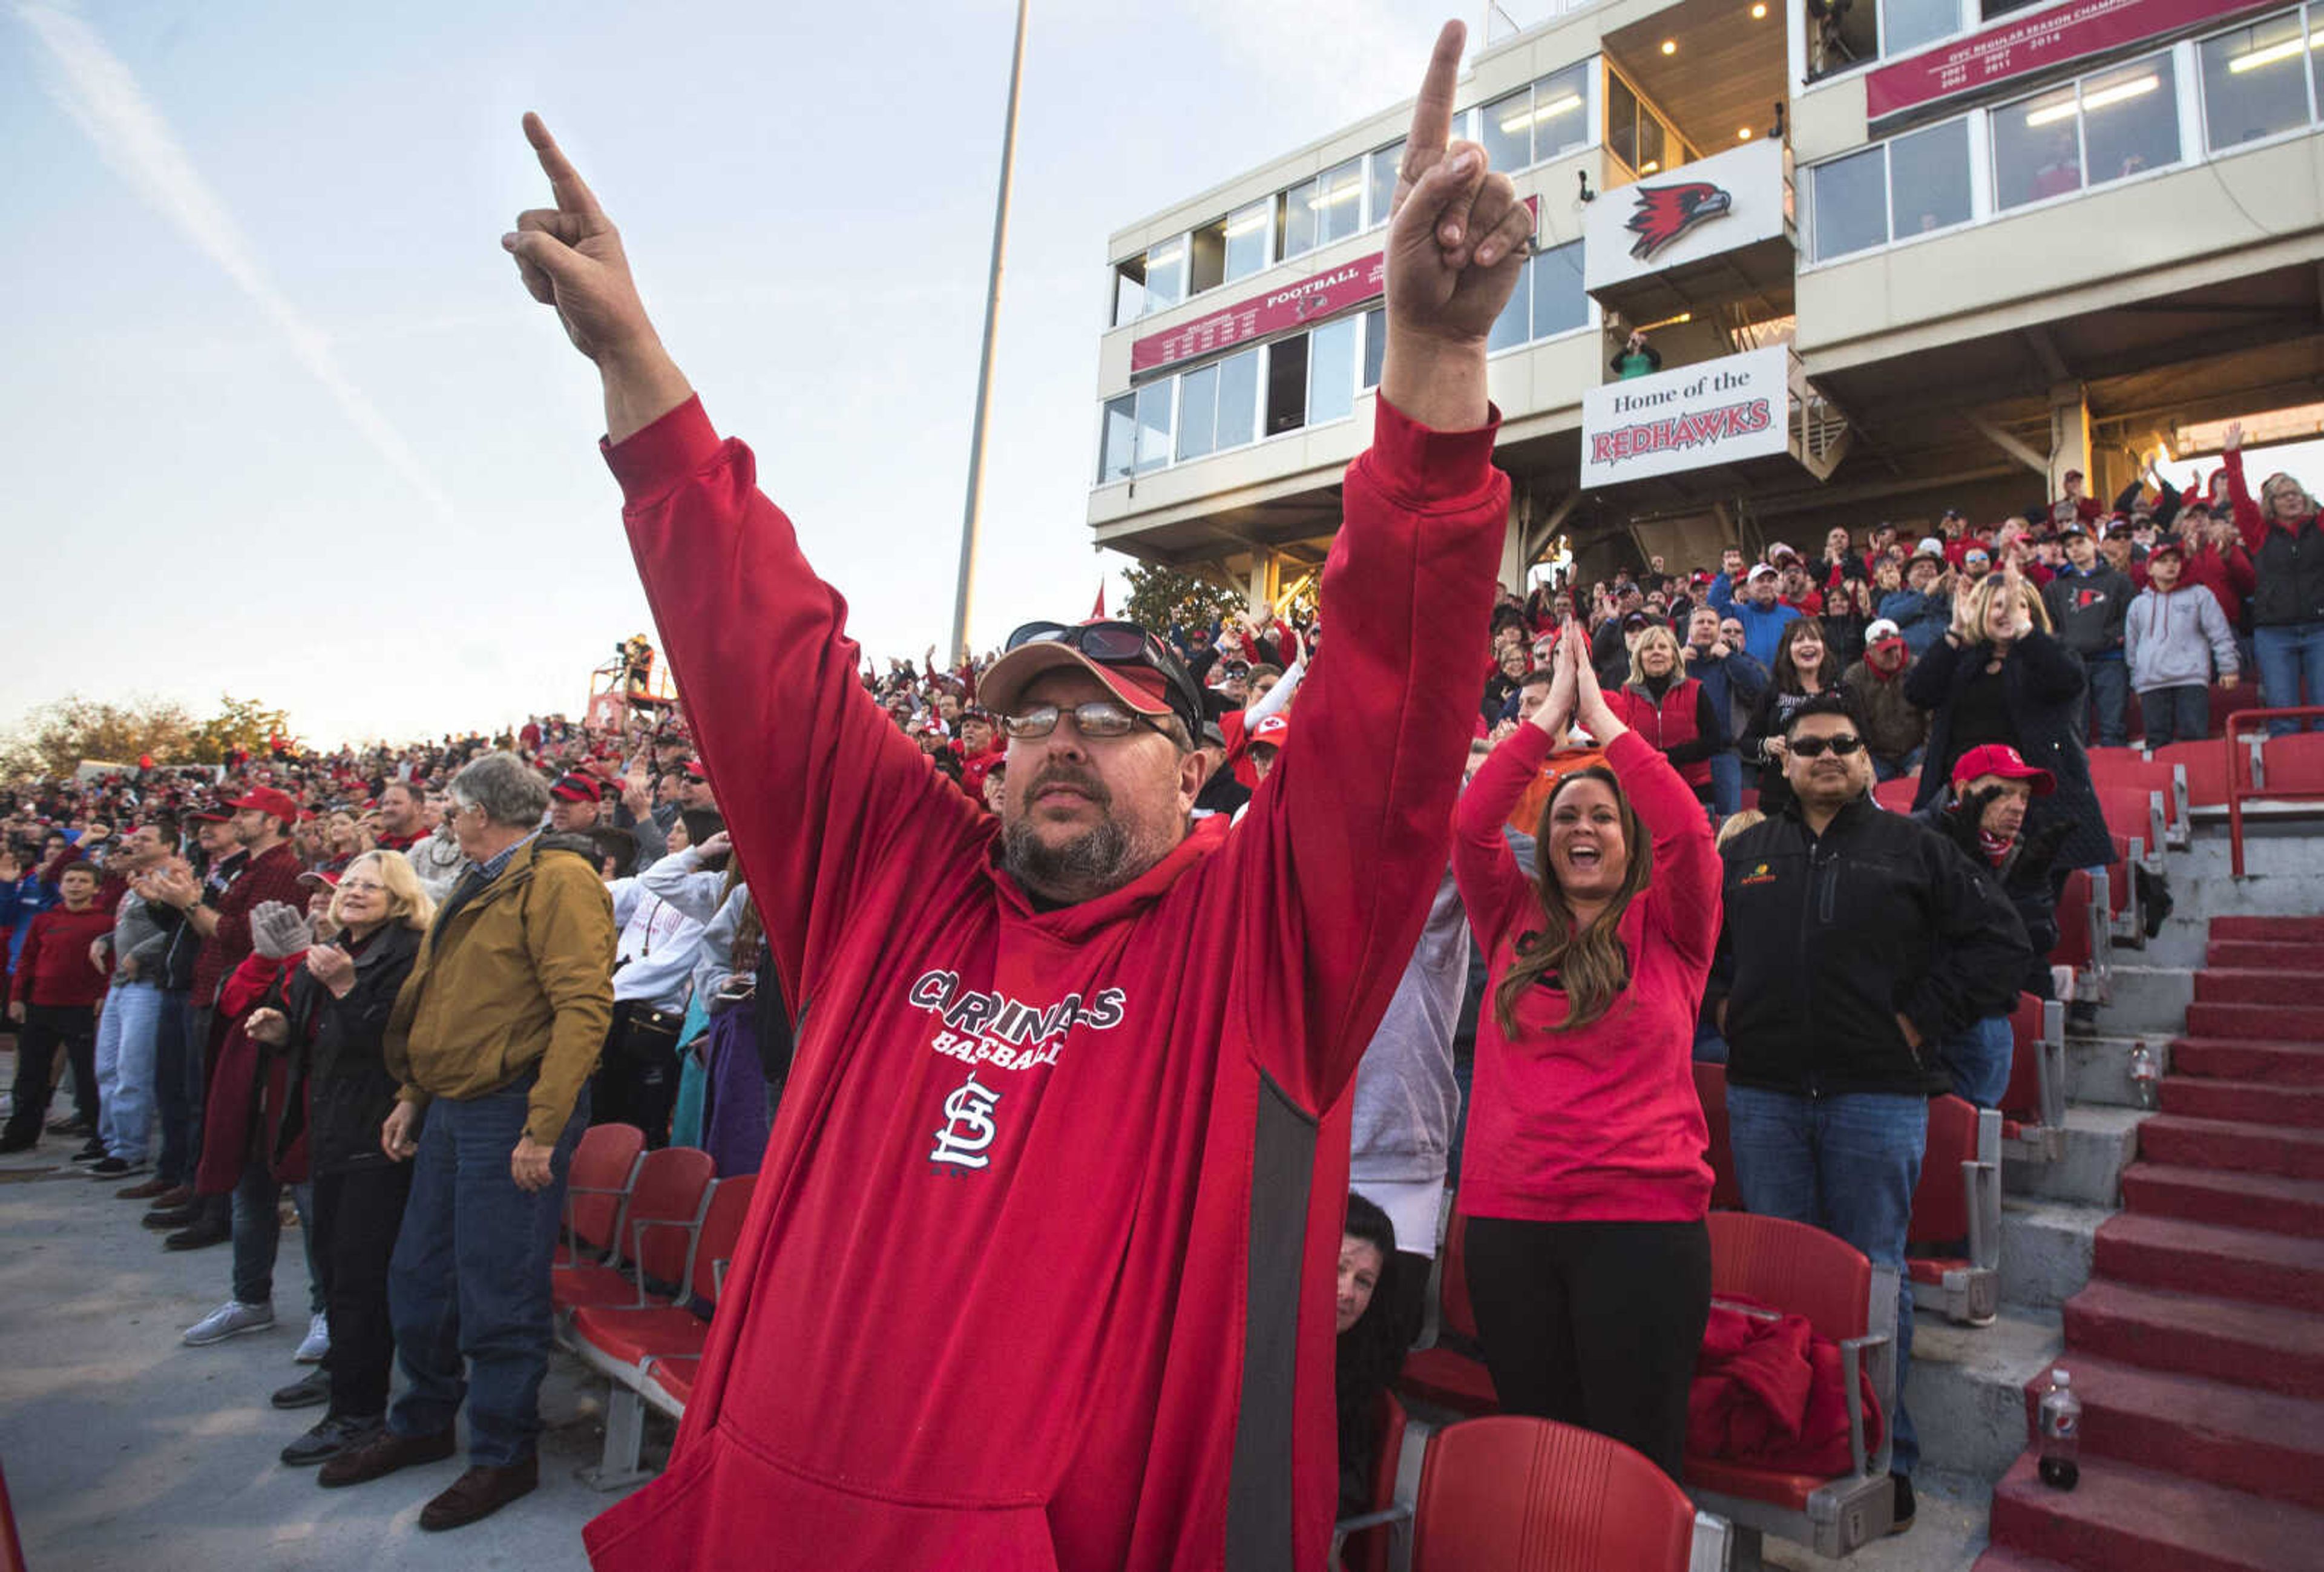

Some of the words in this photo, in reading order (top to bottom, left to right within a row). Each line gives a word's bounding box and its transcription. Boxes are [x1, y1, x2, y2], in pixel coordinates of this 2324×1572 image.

[1974, 30, 2023, 55] REGULAR
[2027, 15, 2071, 33] SEASON
[1985, 60, 2011, 75] 2011
[1267, 268, 1359, 309] FOOTBALL
[1615, 390, 1677, 413] Home
[1683, 376, 1708, 397] of
[1714, 371, 1750, 392] the
[1590, 398, 1771, 466] REDHAWKS
